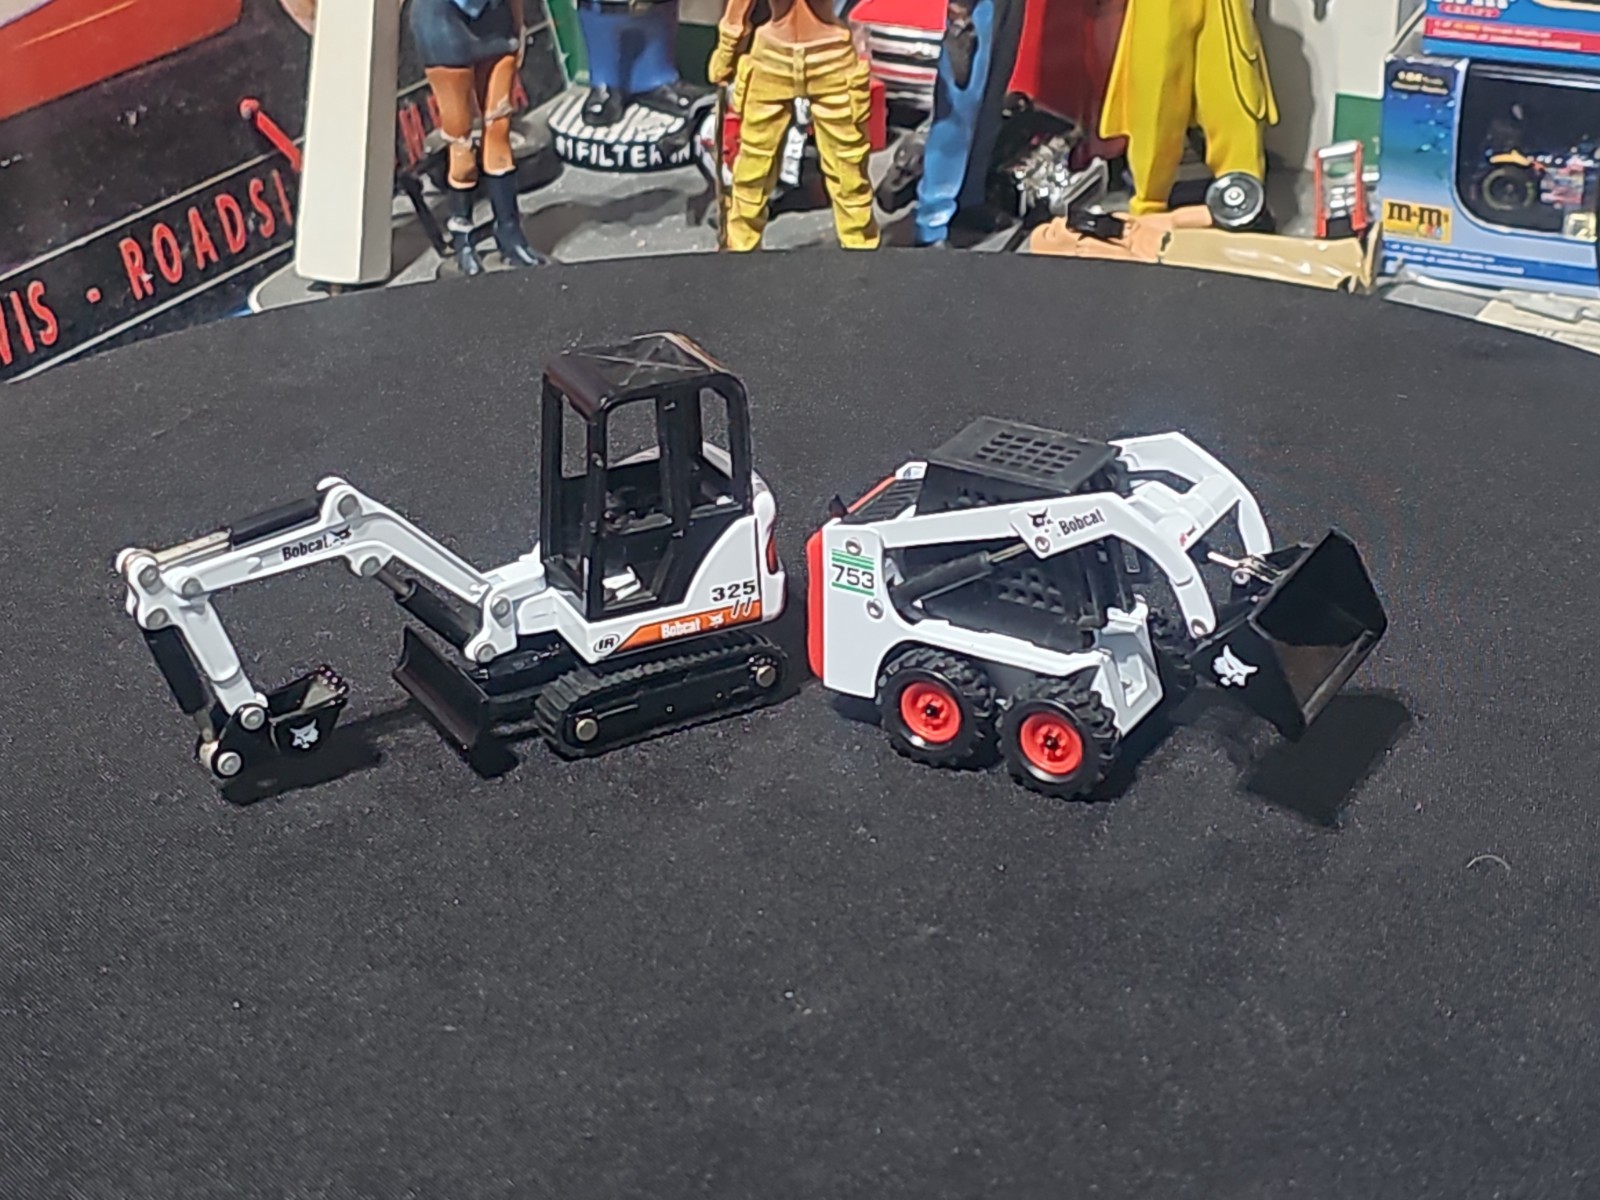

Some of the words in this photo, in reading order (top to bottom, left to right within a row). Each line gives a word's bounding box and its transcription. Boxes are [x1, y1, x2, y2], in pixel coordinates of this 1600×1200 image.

[1058, 508, 1105, 536] Bobcat
[282, 534, 328, 562] Bobcat
[831, 563, 875, 590] 753
[711, 580, 756, 602] 325
[661, 618, 701, 639] Bobcat
